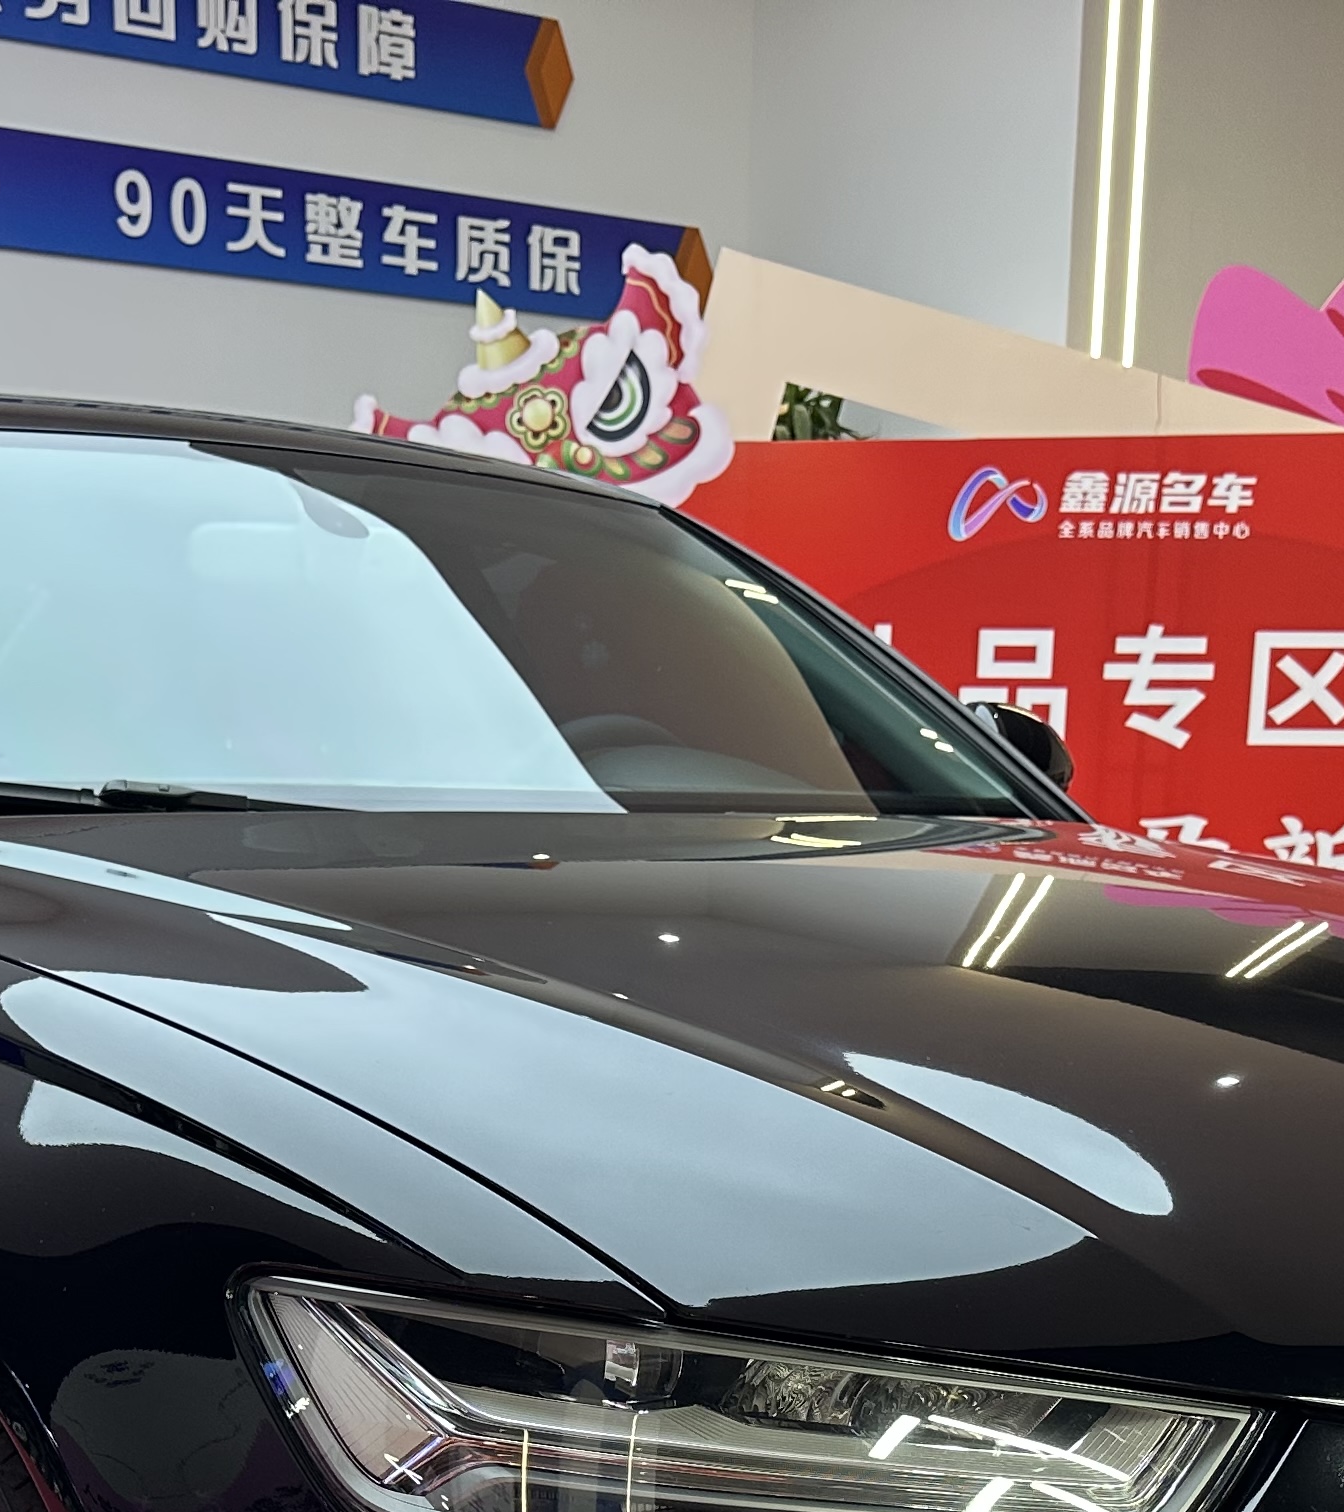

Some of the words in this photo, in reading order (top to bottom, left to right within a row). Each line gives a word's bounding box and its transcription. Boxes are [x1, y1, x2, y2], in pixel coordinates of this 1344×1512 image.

[113, 168, 582, 296] 90天整车质保
[1059, 471, 1257, 514] 鑫源名车
[1058, 519, 1251, 540] 全系品牌汽车销售中心
